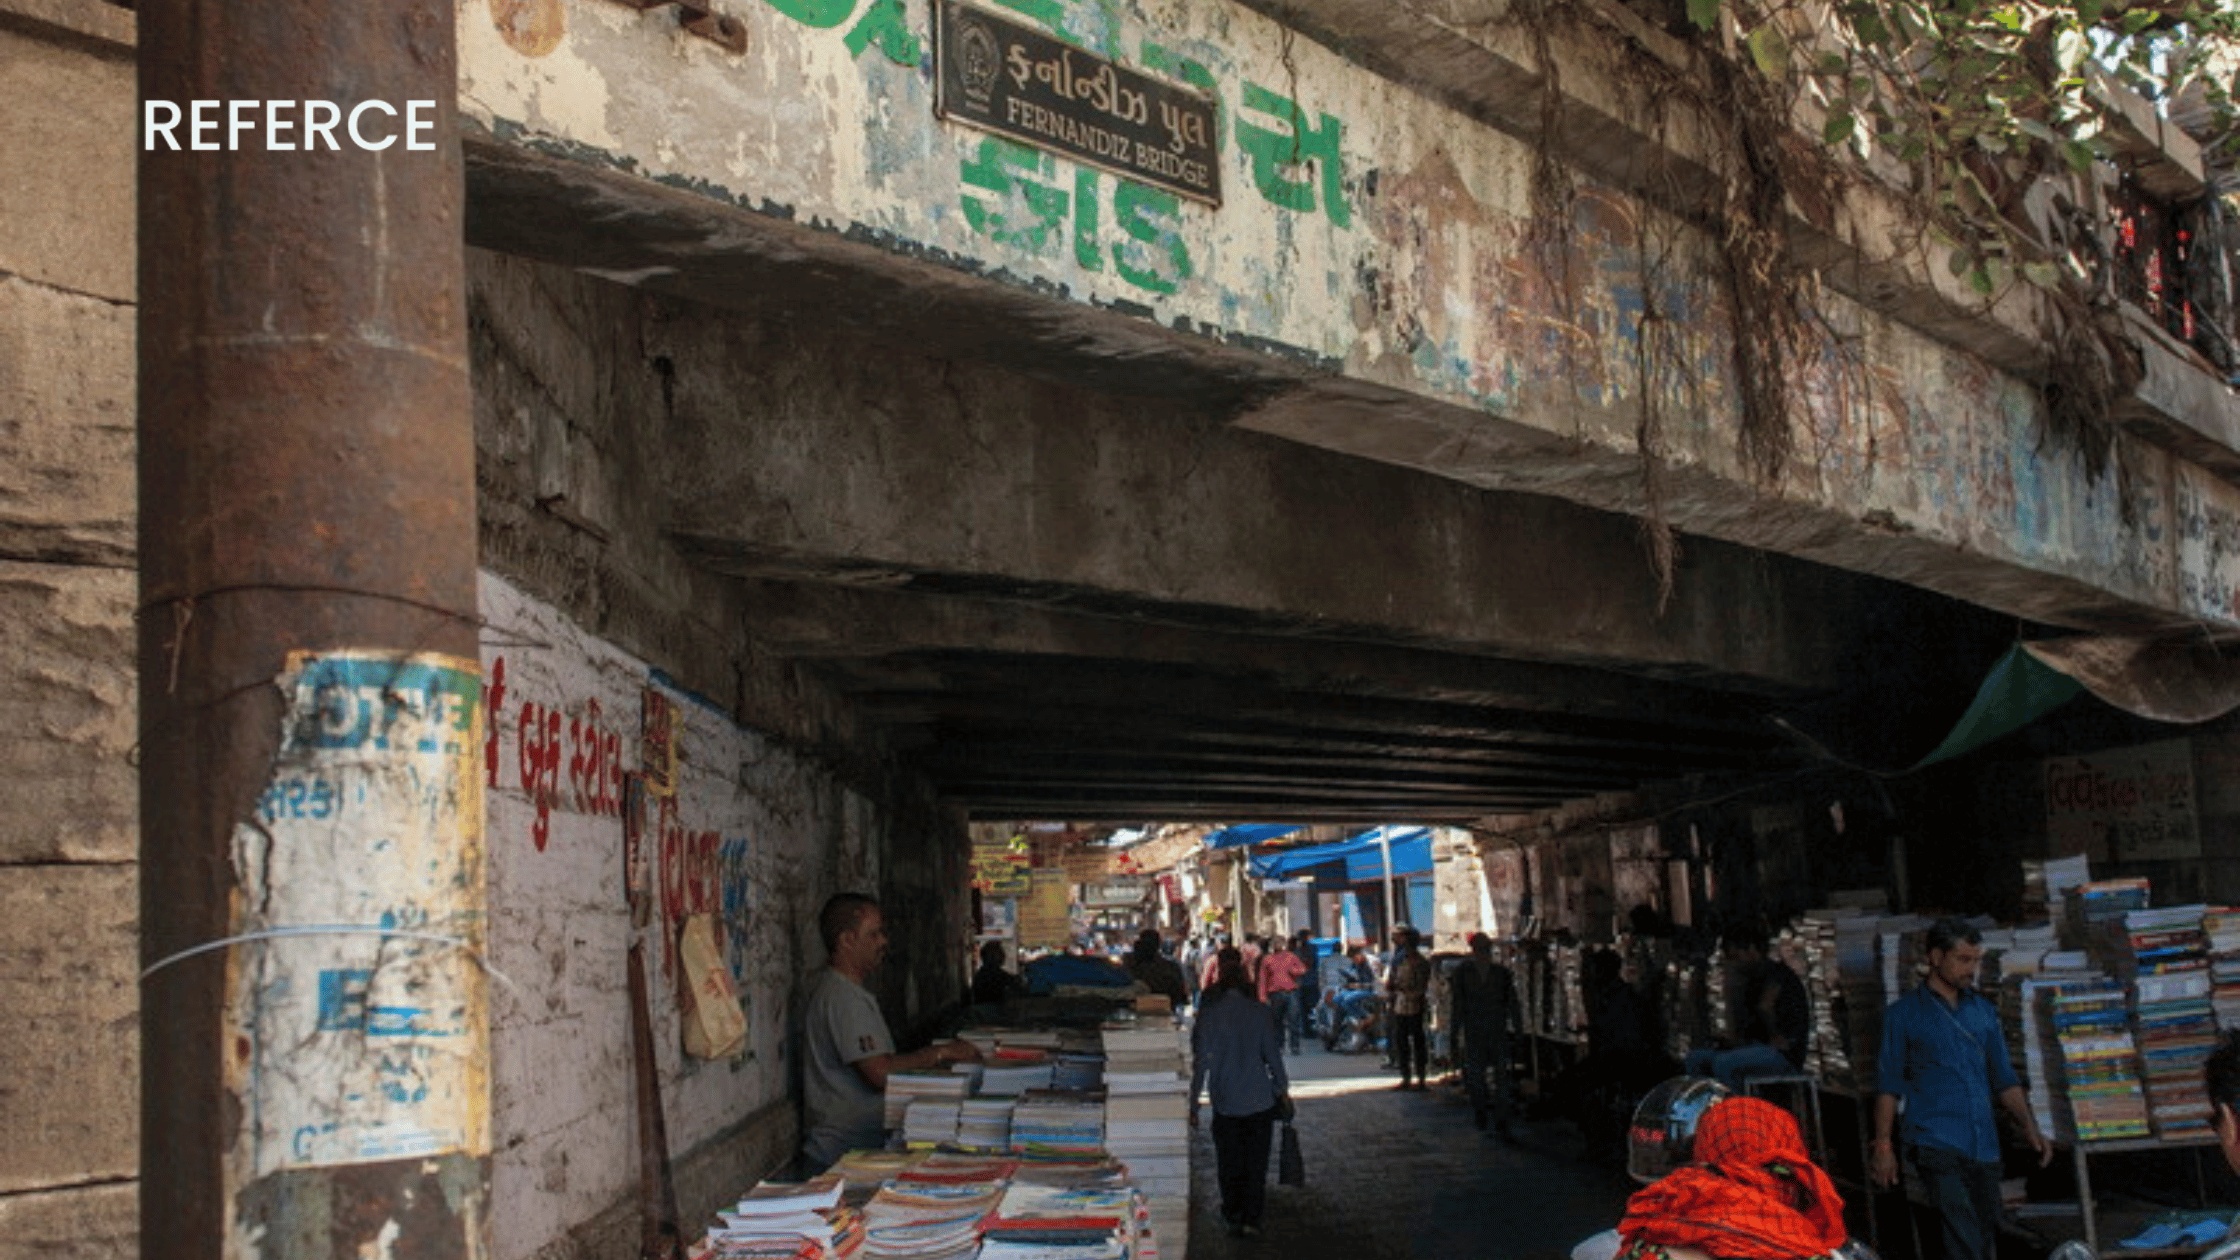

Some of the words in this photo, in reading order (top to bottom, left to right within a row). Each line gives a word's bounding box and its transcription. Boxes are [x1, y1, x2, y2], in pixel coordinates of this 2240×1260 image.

[1007, 95, 1131, 162] FERNANDIZ
[1134, 140, 1209, 189] BRIDGE
[1160, 99, 1208, 153] પુલ
